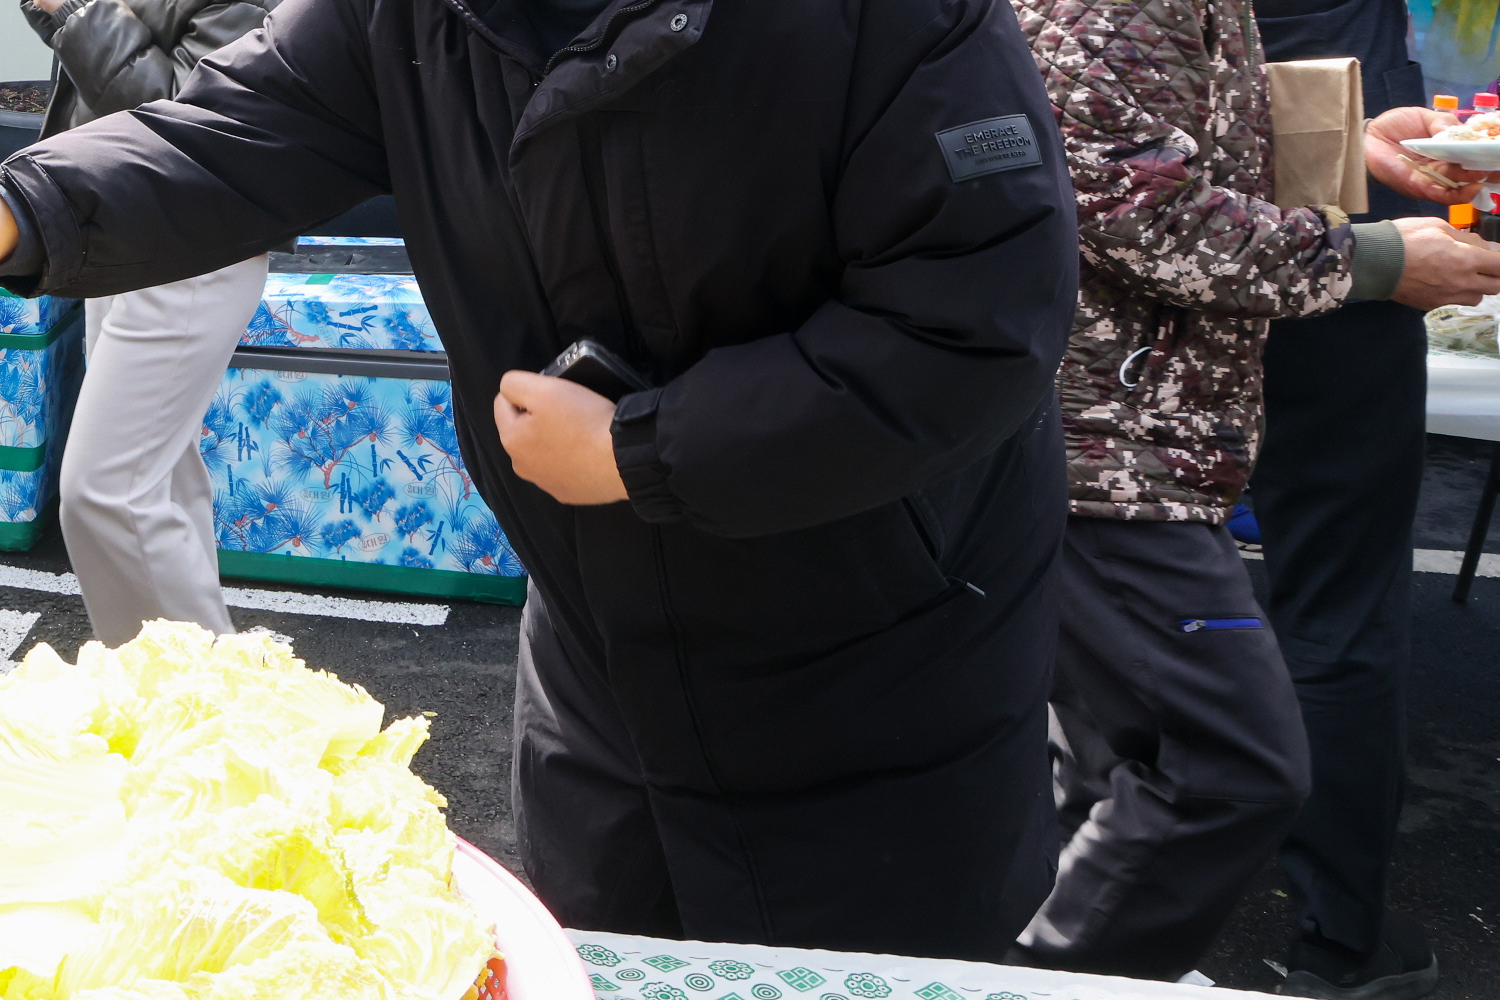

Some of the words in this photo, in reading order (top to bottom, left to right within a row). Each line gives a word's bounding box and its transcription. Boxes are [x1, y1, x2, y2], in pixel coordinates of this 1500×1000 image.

[965, 125, 1018, 143] EMBRACE
[955, 145, 979, 160] THE
[981, 136, 1031, 153] FREEDOM
